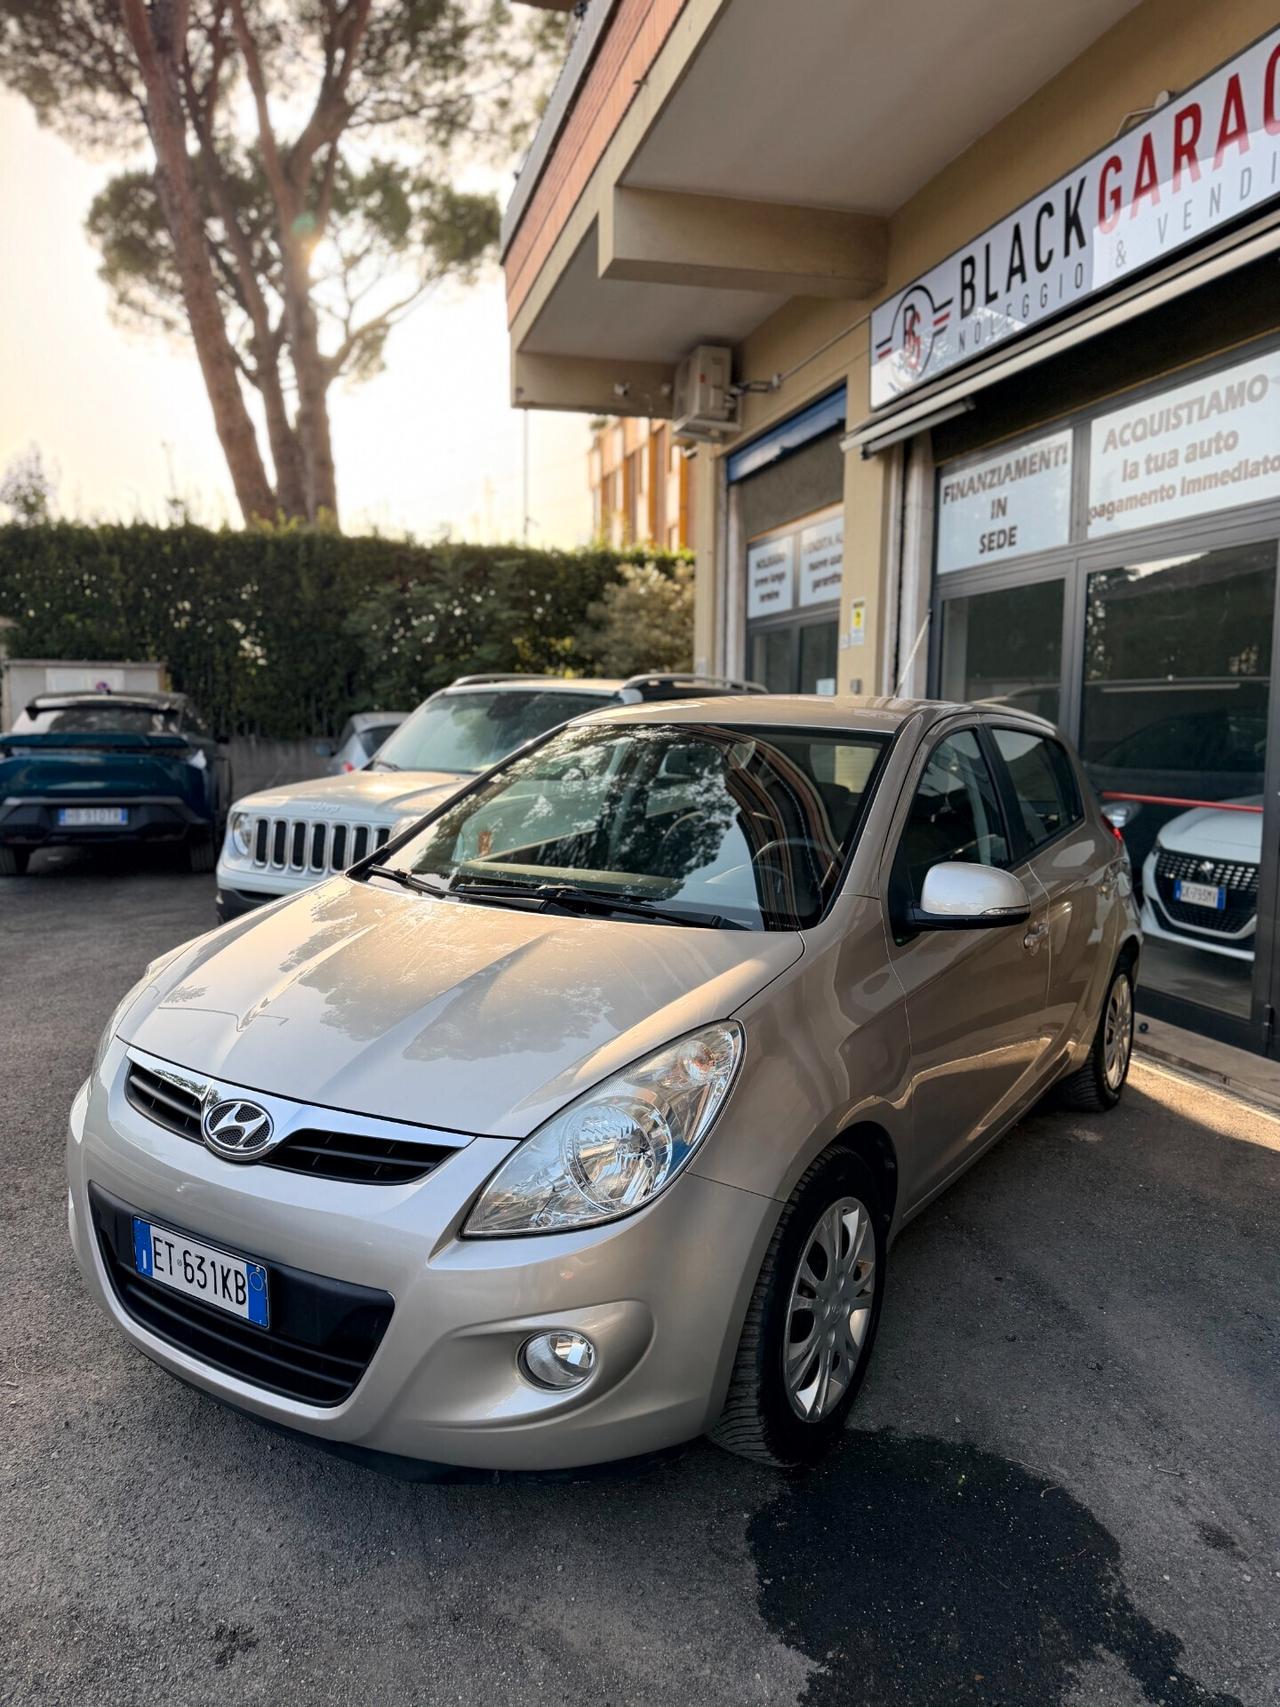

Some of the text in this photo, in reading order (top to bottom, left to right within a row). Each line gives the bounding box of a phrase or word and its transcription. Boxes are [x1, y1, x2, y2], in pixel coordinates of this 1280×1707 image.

[958, 262, 1084, 354] NOLEGGIO
[1115, 239, 1127, 268] &
[1102, 373, 1269, 455] ACQUISTIAMO
[1122, 430, 1239, 482] la tua auto
[990, 497, 1008, 520] IN
[1087, 454, 1280, 526] pagamento immediato
[979, 525, 1018, 554] SEDE
